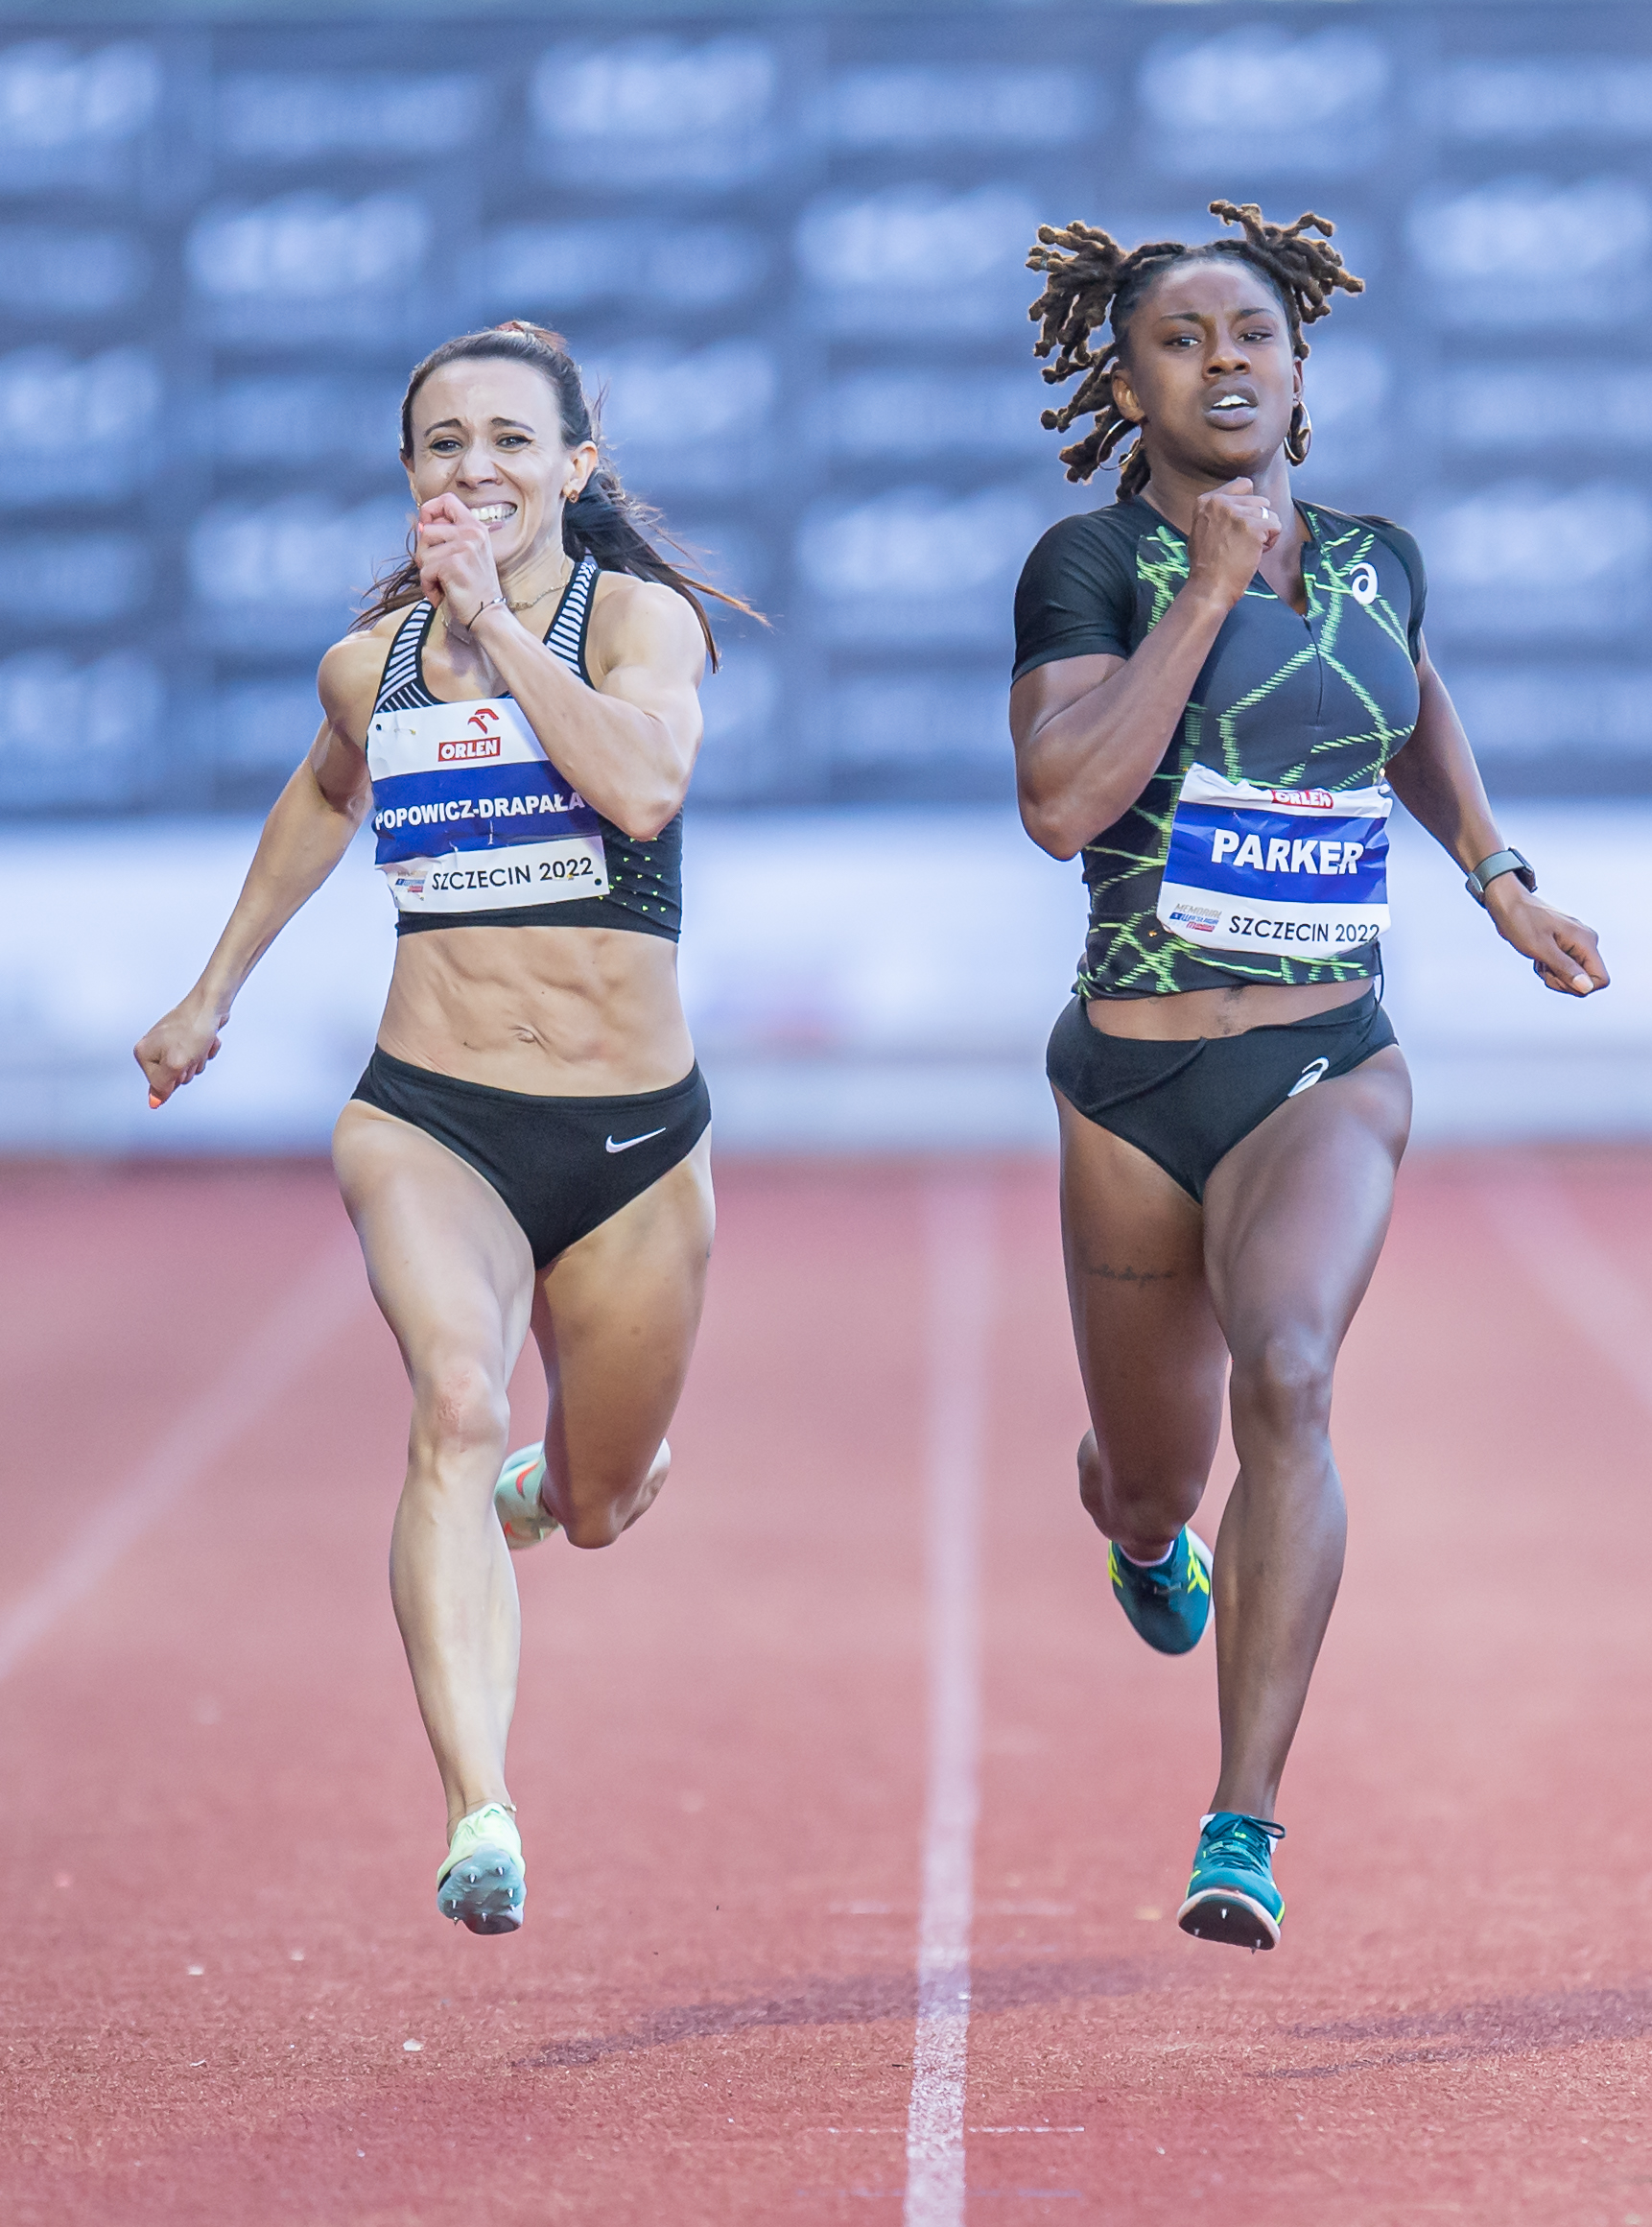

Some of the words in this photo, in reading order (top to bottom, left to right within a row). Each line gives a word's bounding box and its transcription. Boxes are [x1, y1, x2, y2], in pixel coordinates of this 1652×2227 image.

[441, 739, 497, 759] ORLEN
[375, 792, 585, 831] POPOWICZ-DRAPAŁA
[1275, 790, 1332, 807] ORLEN
[1211, 828, 1364, 875] PARKER
[432, 865, 531, 889] SZCZECIN
[539, 857, 593, 881] 2022
[1229, 915, 1329, 942] SZCZECIN
[1335, 924, 1380, 942] 2022
